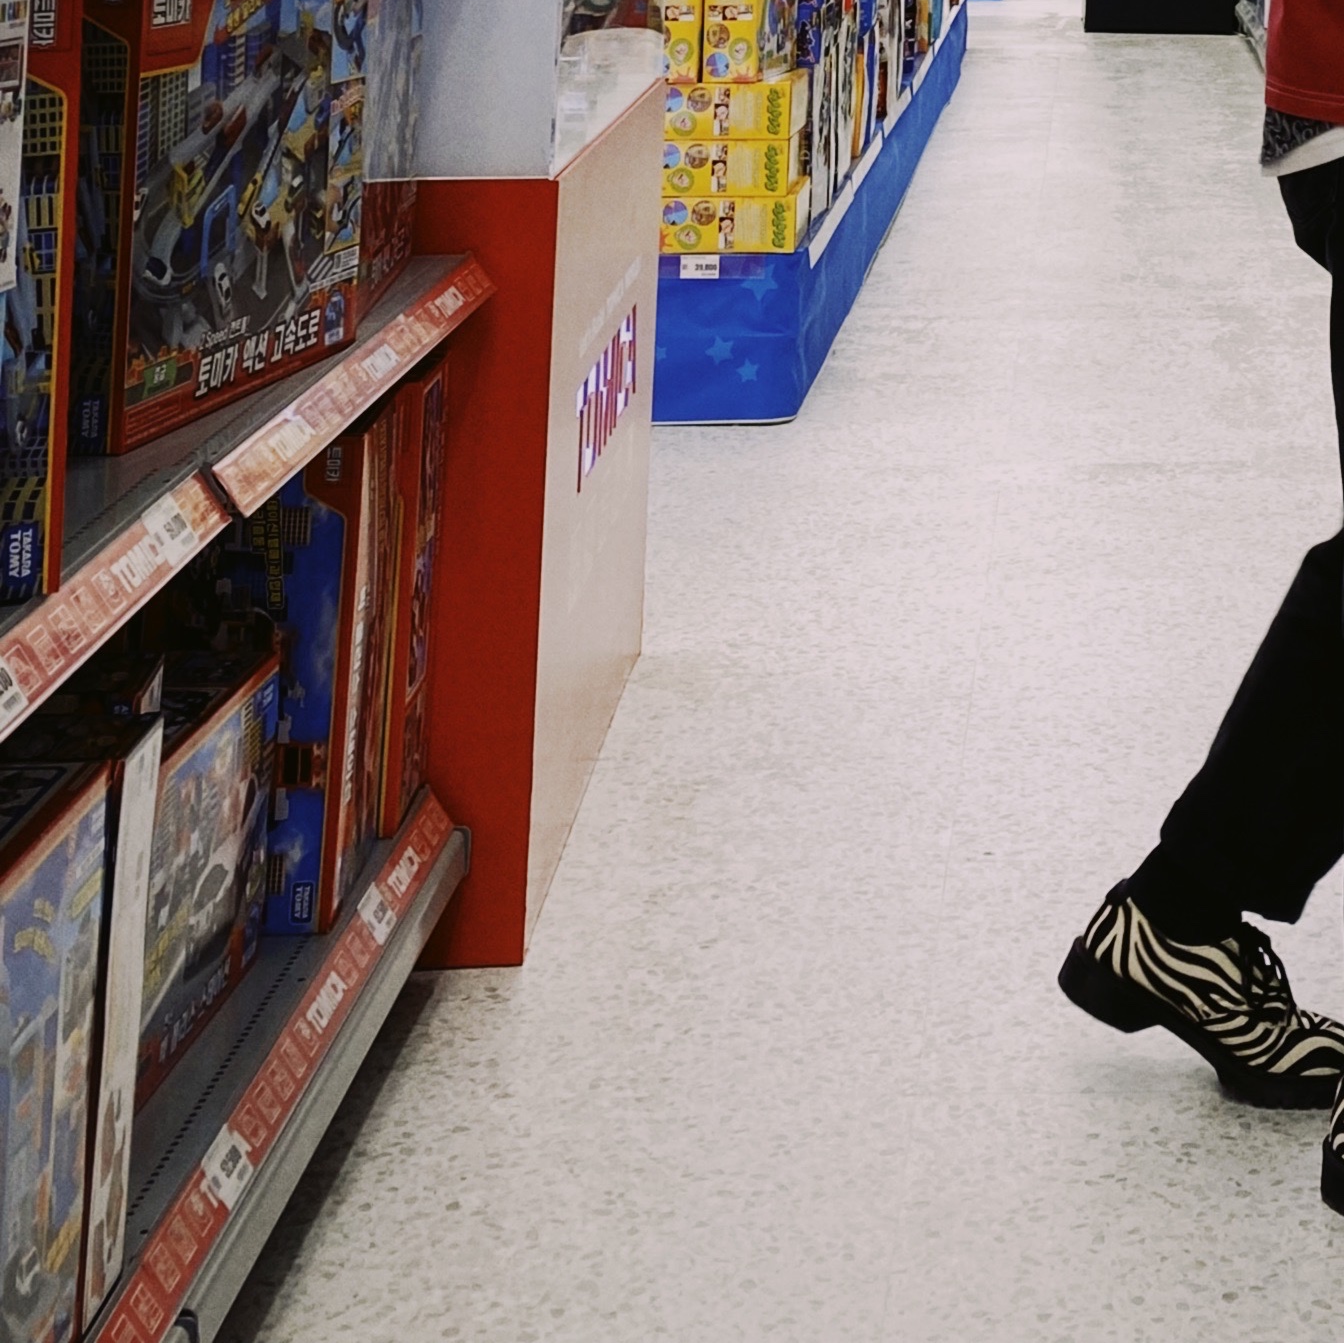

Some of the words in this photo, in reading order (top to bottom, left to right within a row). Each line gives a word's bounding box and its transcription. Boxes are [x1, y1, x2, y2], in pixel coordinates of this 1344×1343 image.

[194, 348, 239, 398] 토미카
[241, 331, 270, 373] 액션
[270, 308, 322, 362] 고속도로
[205, 326, 229, 348] Speed
[326, 447, 342, 482] 토미카
[8, 530, 21, 578] TOMY
[21, 528, 33, 578] TAKARA
[112, 540, 162, 592] TOMIC
[388, 844, 420, 897] TOMICA
[305, 972, 347, 1036] TOMICA
